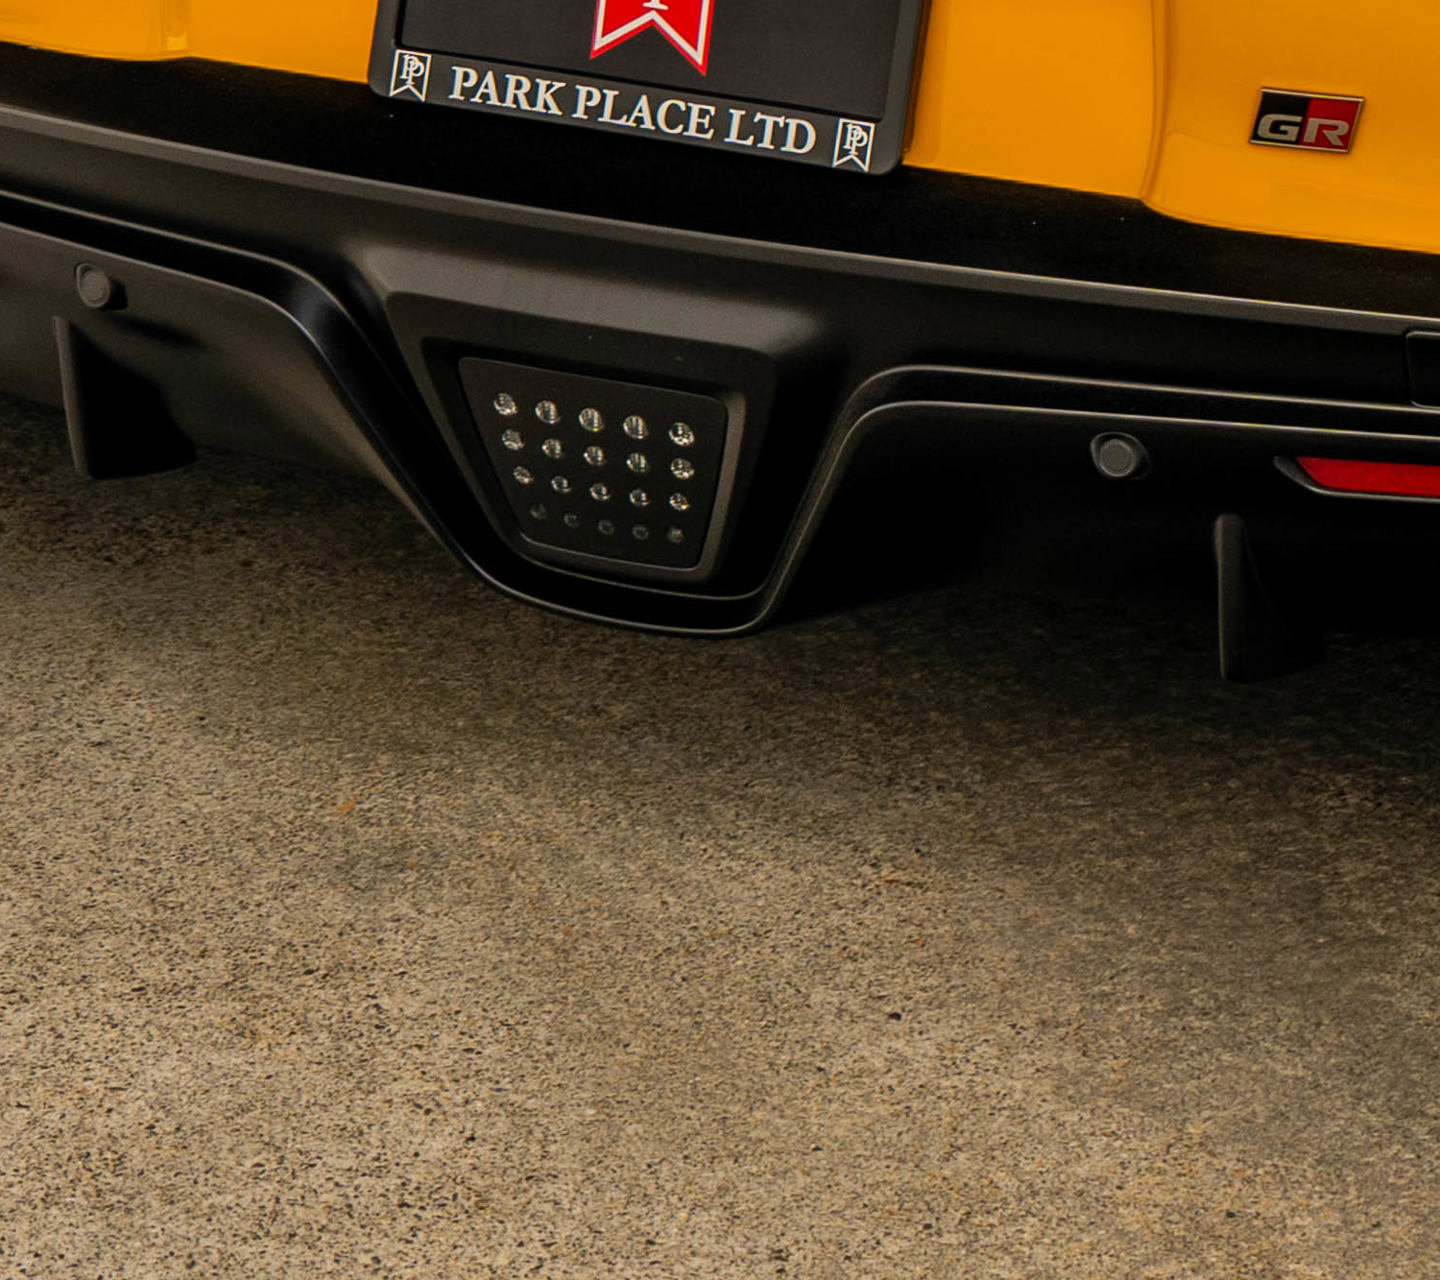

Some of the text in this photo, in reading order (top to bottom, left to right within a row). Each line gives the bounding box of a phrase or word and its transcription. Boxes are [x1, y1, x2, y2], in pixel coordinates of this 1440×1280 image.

[448, 65, 817, 155] PARK PLACE LTD
[1257, 113, 1349, 146] GR
